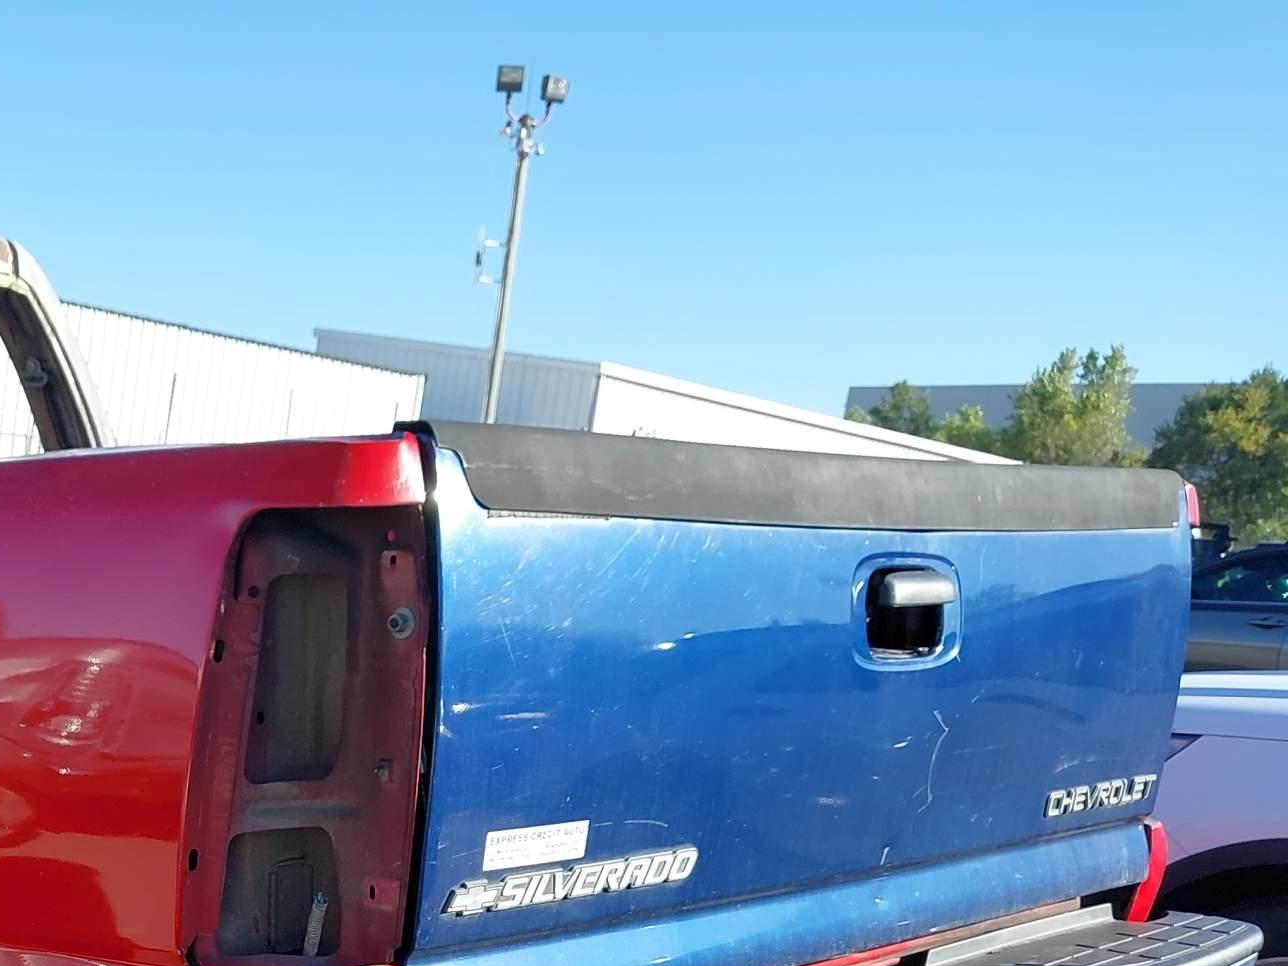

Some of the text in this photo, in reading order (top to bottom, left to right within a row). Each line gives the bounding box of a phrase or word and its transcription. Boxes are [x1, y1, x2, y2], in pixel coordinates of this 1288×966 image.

[1045, 774, 1158, 817] CHEVROLET
[489, 831, 530, 847] EXPRESS
[563, 825, 585, 838] AUTO
[494, 846, 699, 910] SILVERADO
